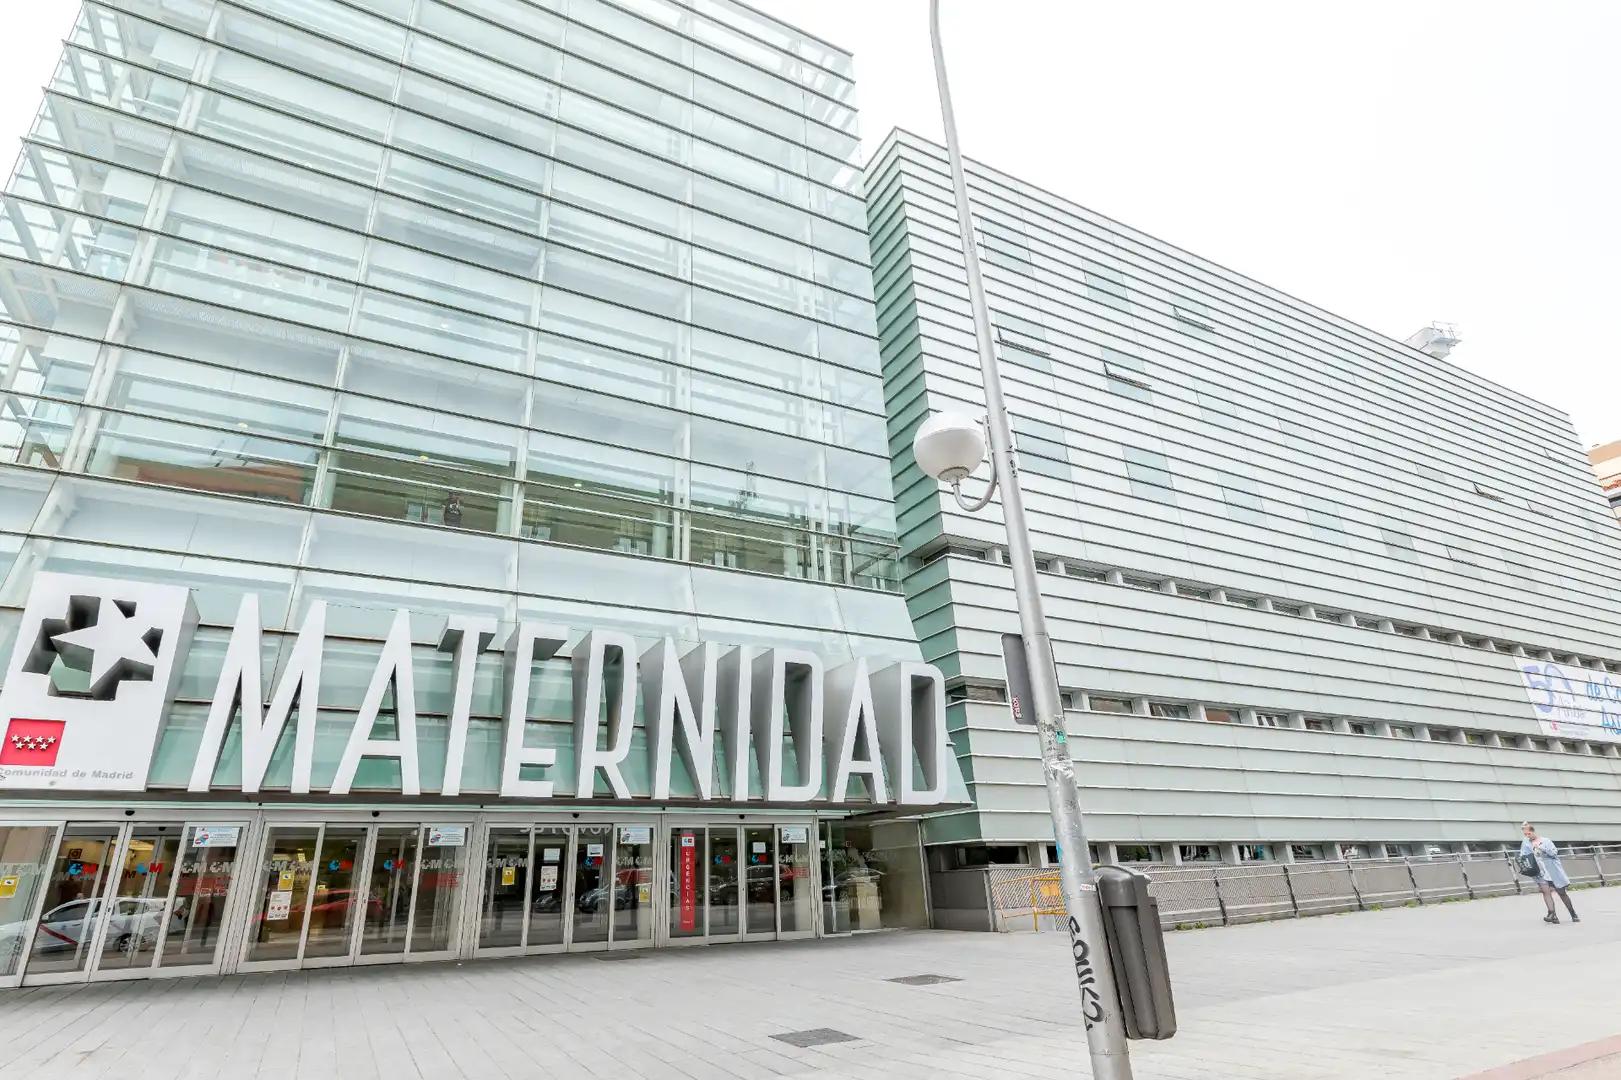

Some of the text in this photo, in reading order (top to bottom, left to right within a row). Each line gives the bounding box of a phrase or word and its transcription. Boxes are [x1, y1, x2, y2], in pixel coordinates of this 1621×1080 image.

[187, 593, 947, 806] MATERNIDAD
[0, 767, 134, 780] Comunidad de Madrid
